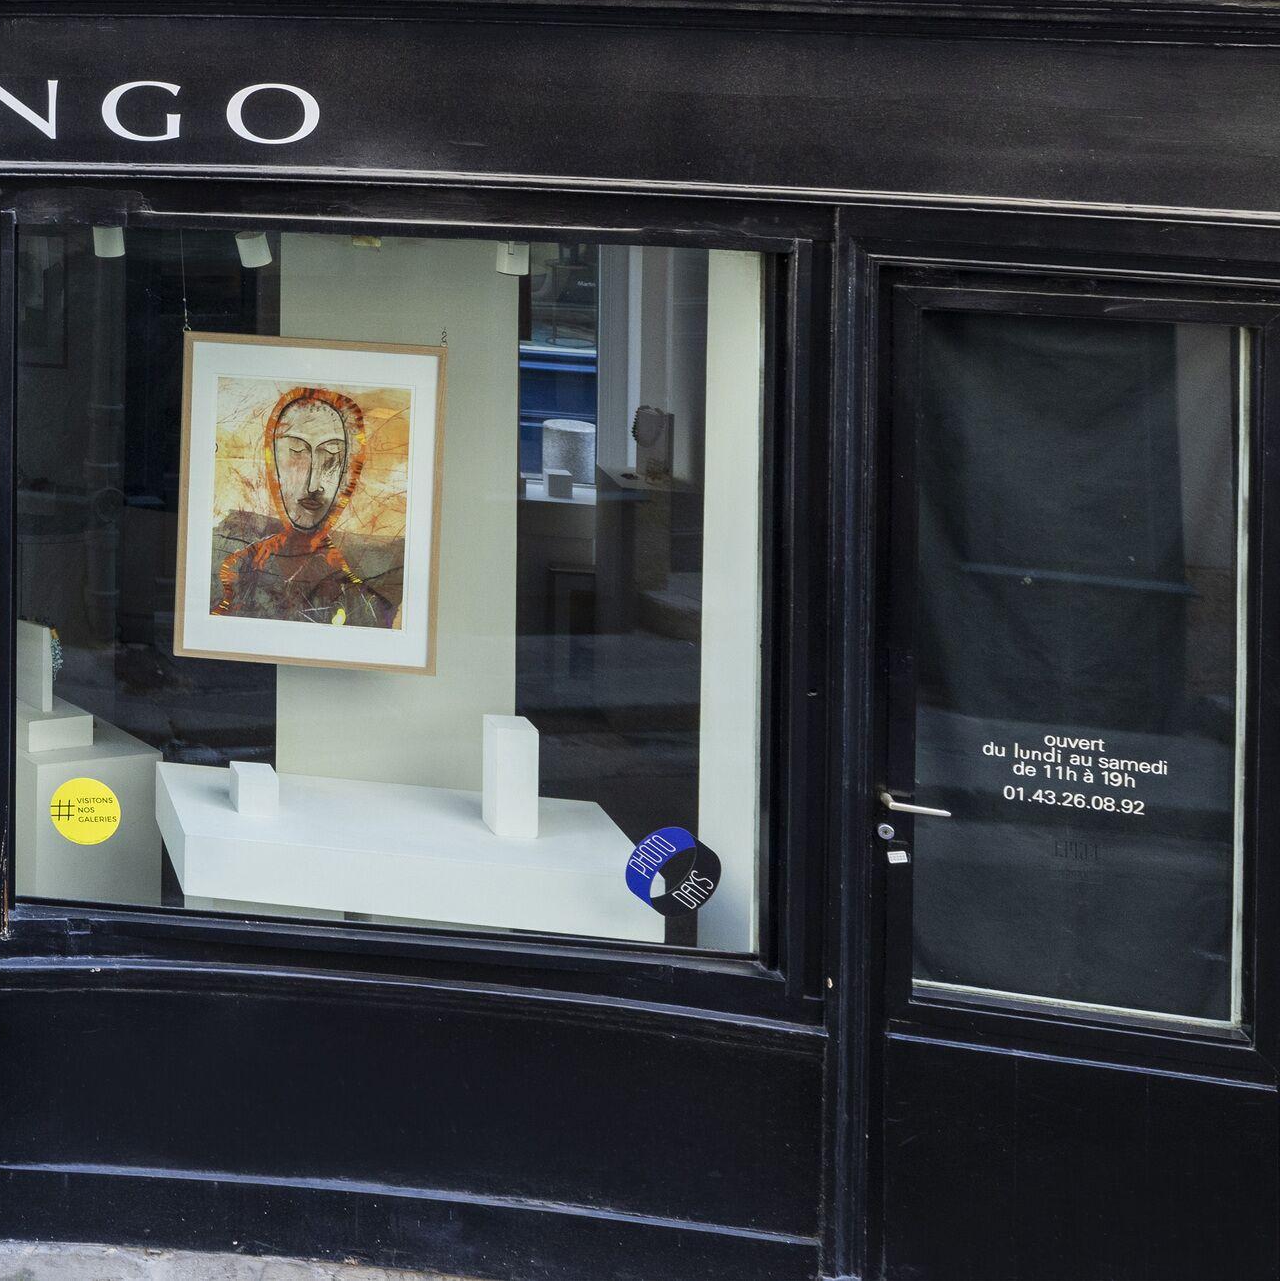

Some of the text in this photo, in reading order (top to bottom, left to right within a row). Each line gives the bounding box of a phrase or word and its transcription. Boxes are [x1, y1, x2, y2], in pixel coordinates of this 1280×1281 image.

[982, 741, 1168, 776] du lundi au samedi
[1044, 735, 1105, 752] ouvert
[1013, 761, 1136, 788] de 11h à 19h
[1003, 785, 1145, 815] 01.43.26.08.92
[628, 834, 677, 879] PHOTO
[672, 870, 714, 909] DAYS
